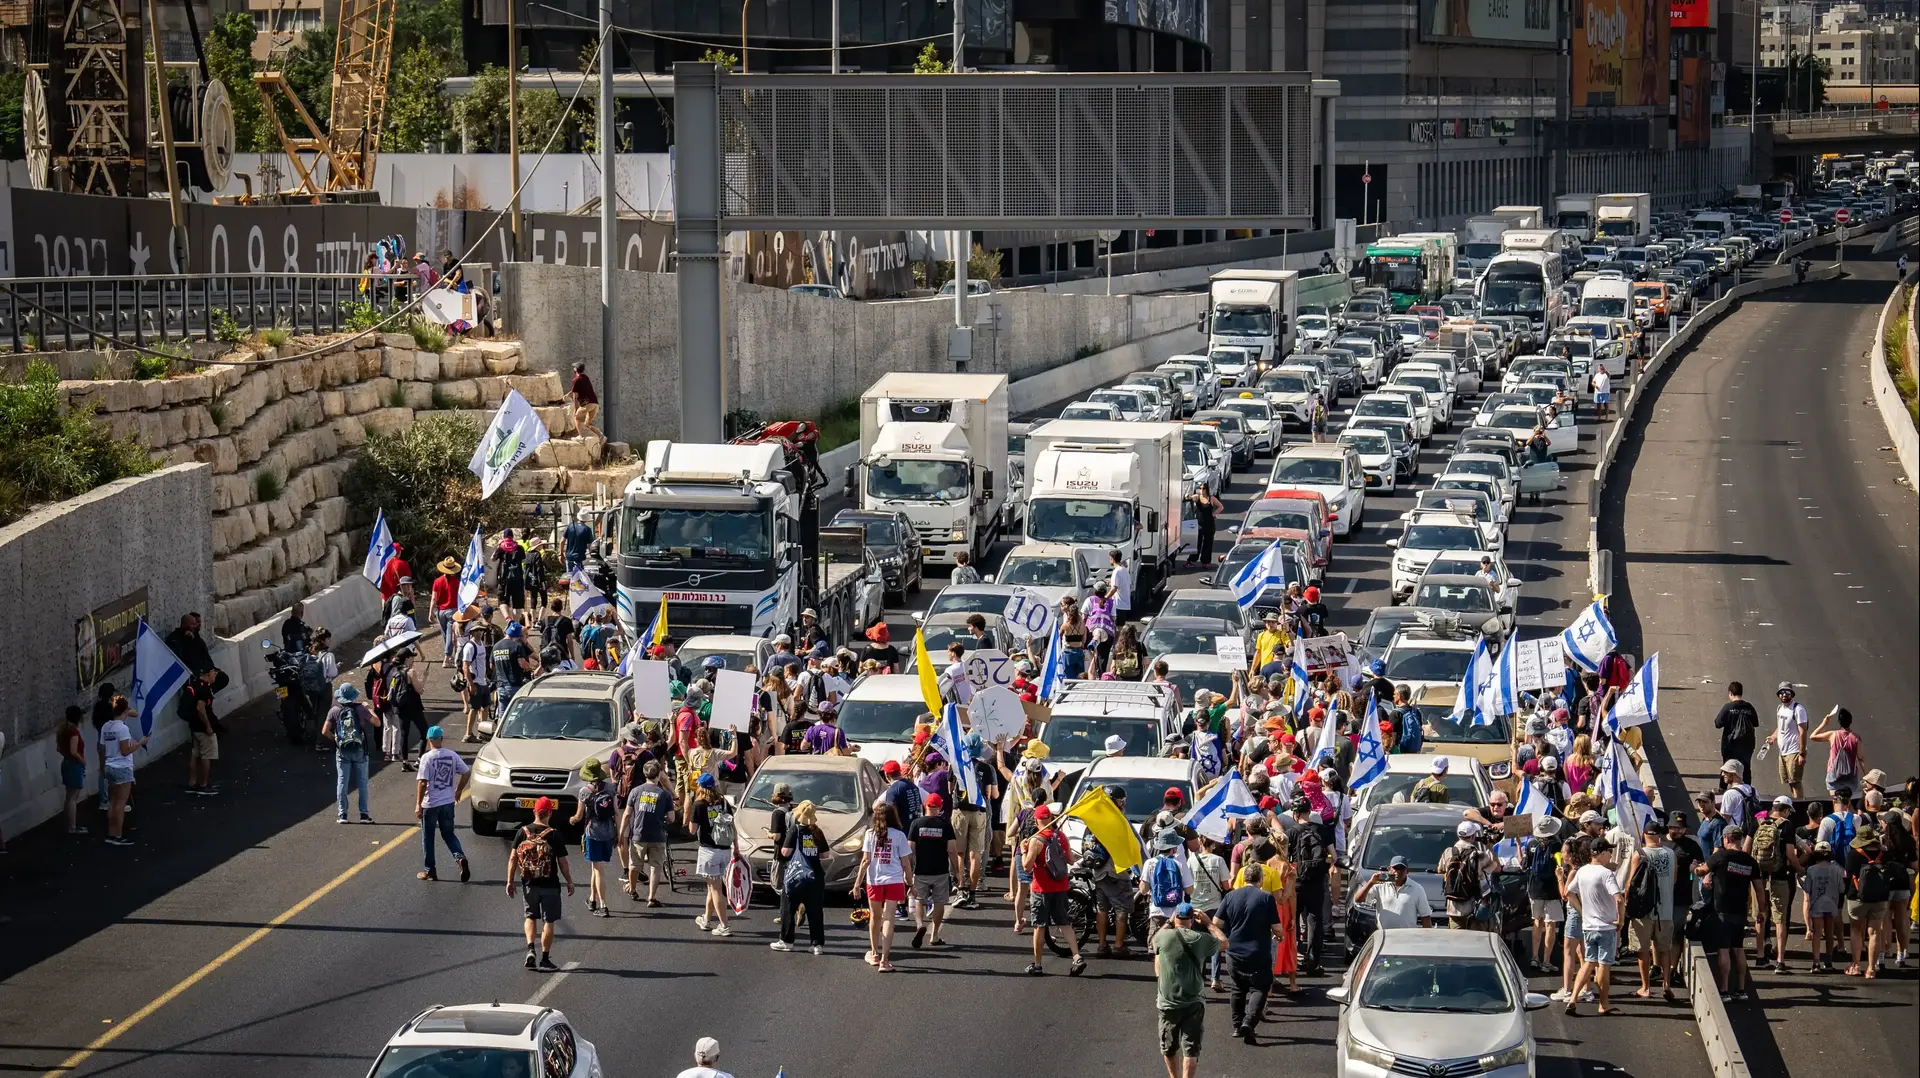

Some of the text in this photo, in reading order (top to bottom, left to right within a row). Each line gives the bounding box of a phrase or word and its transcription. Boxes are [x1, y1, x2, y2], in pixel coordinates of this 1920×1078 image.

[880, 239, 907, 270] ישראל
[682, 592, 708, 601] הובלות
[1008, 595, 1048, 632] 10
[802, 847, 818, 857] NOW!
